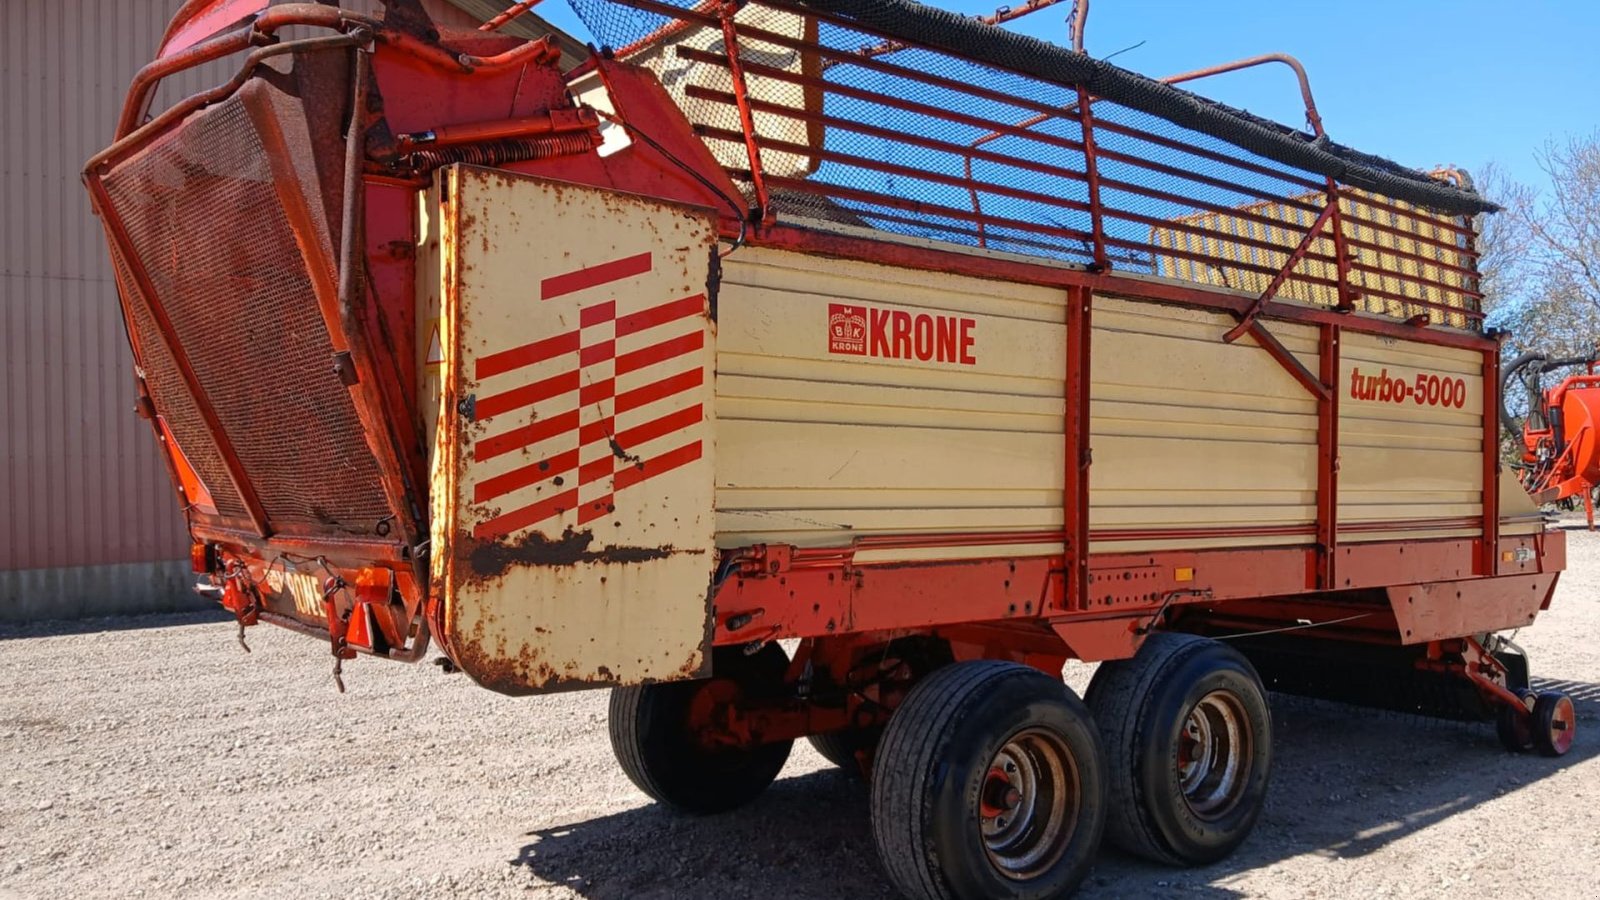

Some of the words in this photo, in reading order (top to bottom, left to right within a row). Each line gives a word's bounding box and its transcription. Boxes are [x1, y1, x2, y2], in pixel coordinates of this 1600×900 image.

[835, 326, 843, 336] B
[853, 328, 860, 338] K
[870, 308, 976, 365] KRONE
[832, 341, 863, 352] KRONE
[1350, 367, 1466, 409] turbo-5000
